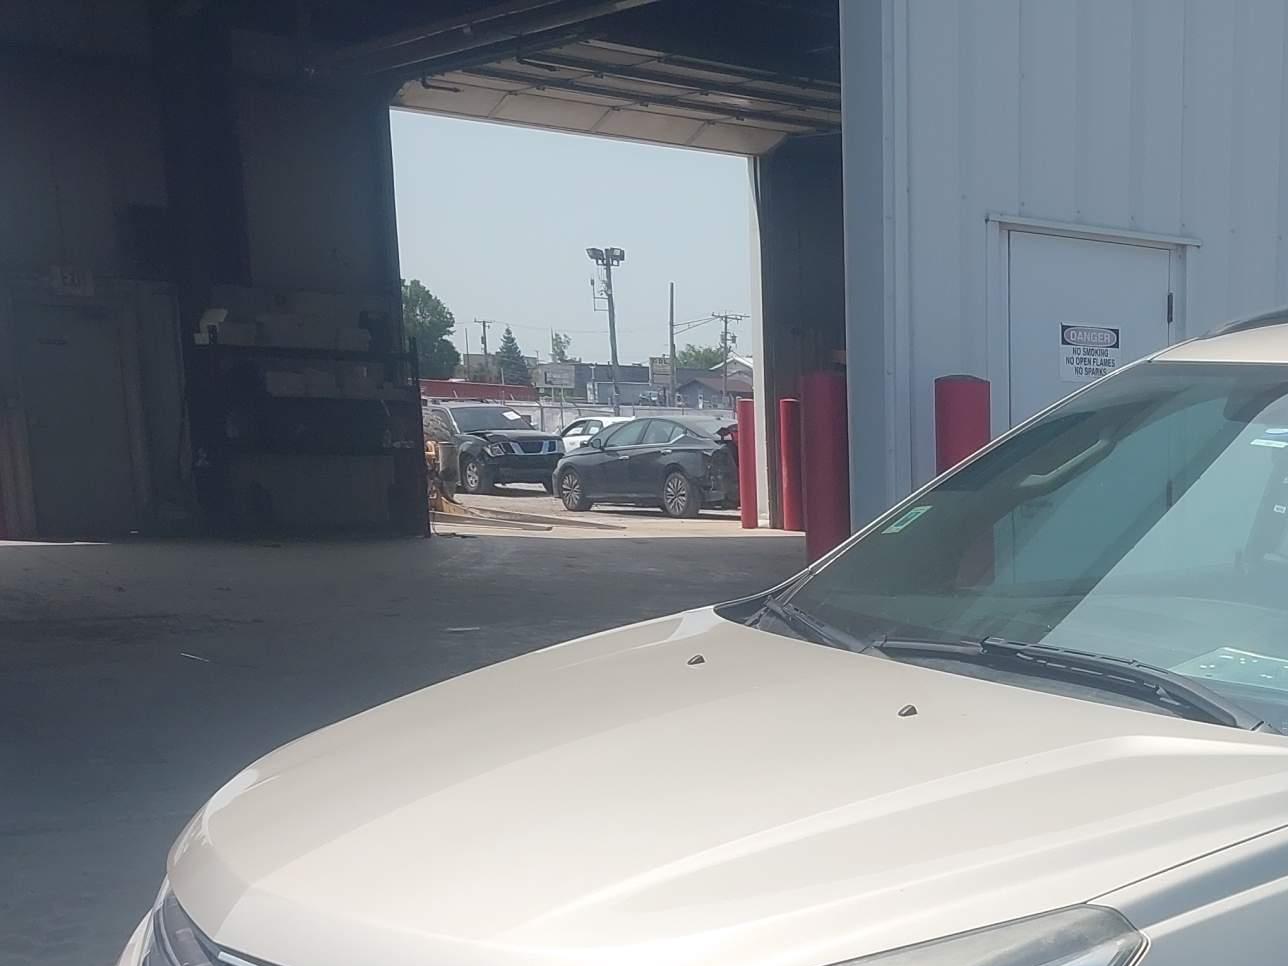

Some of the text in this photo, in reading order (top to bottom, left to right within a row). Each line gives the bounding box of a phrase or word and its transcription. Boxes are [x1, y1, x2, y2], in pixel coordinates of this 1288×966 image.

[1070, 330, 1111, 343] DANGER
[1072, 347, 1108, 357] NO SMOKING
[1065, 357, 1116, 367] NO OPEN FLAMES
[1074, 366, 1107, 376] NO SPARKS
